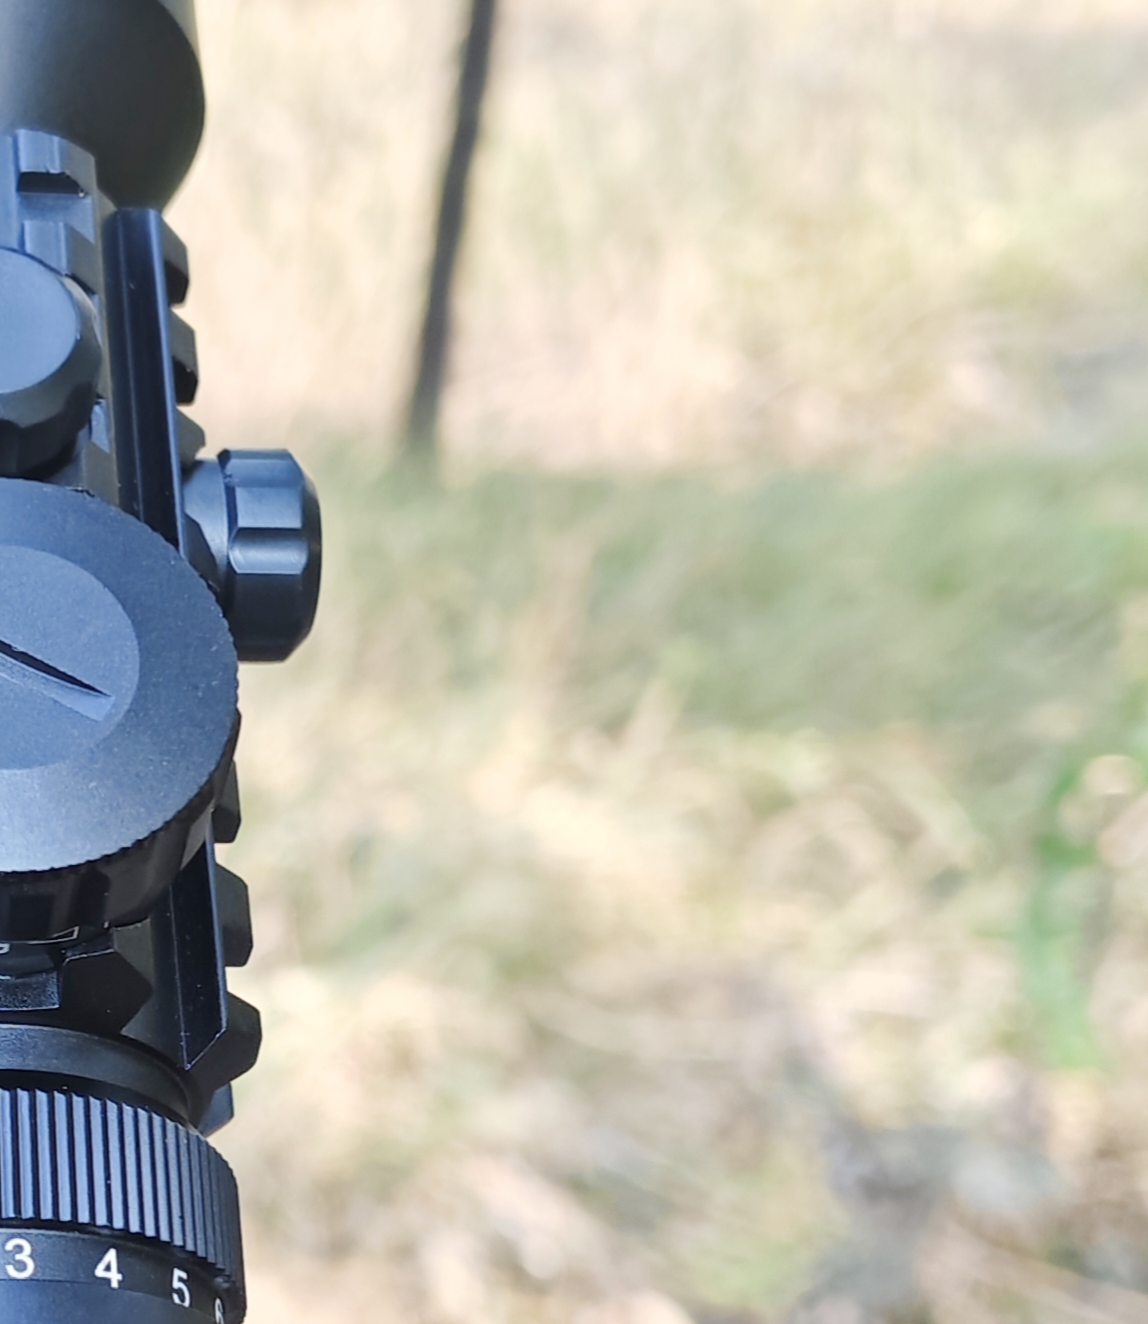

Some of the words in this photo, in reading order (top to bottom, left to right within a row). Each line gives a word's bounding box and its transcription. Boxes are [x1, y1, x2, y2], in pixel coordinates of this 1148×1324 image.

[4, 1237, 35, 1280] 3
[94, 1248, 123, 1289] 4
[172, 1267, 191, 1308] 5
